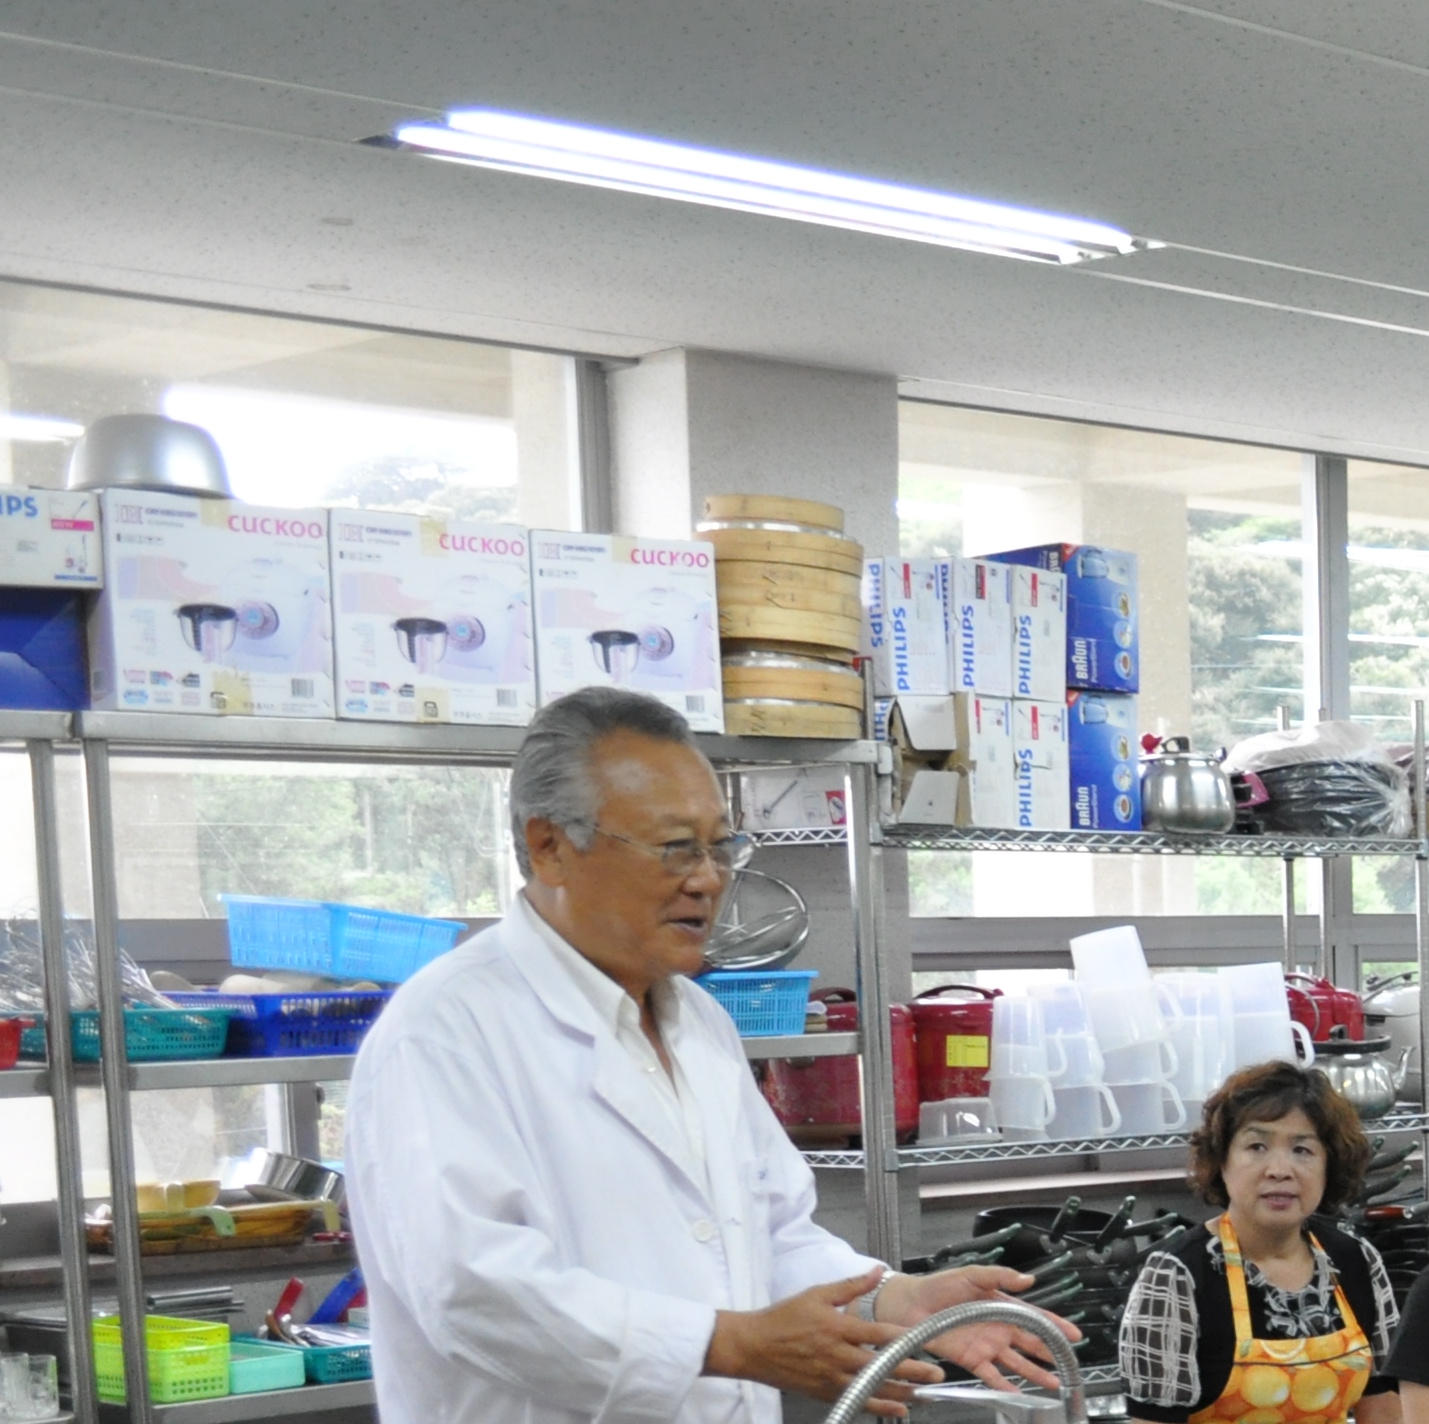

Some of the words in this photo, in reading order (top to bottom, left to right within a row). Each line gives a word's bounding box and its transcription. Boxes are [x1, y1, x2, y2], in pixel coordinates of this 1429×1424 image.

[227, 514, 324, 540] CUCKOO
[439, 532, 525, 557] CUCKOO
[630, 548, 710, 568] CUCKOO
[868, 563, 885, 649] PHILIPS
[961, 604, 975, 688] PHILIPS
[892, 606, 911, 692] PHILIPS
[1018, 614, 1032, 696] PHILIPS
[1018, 748, 1034, 828] PHILIPS
